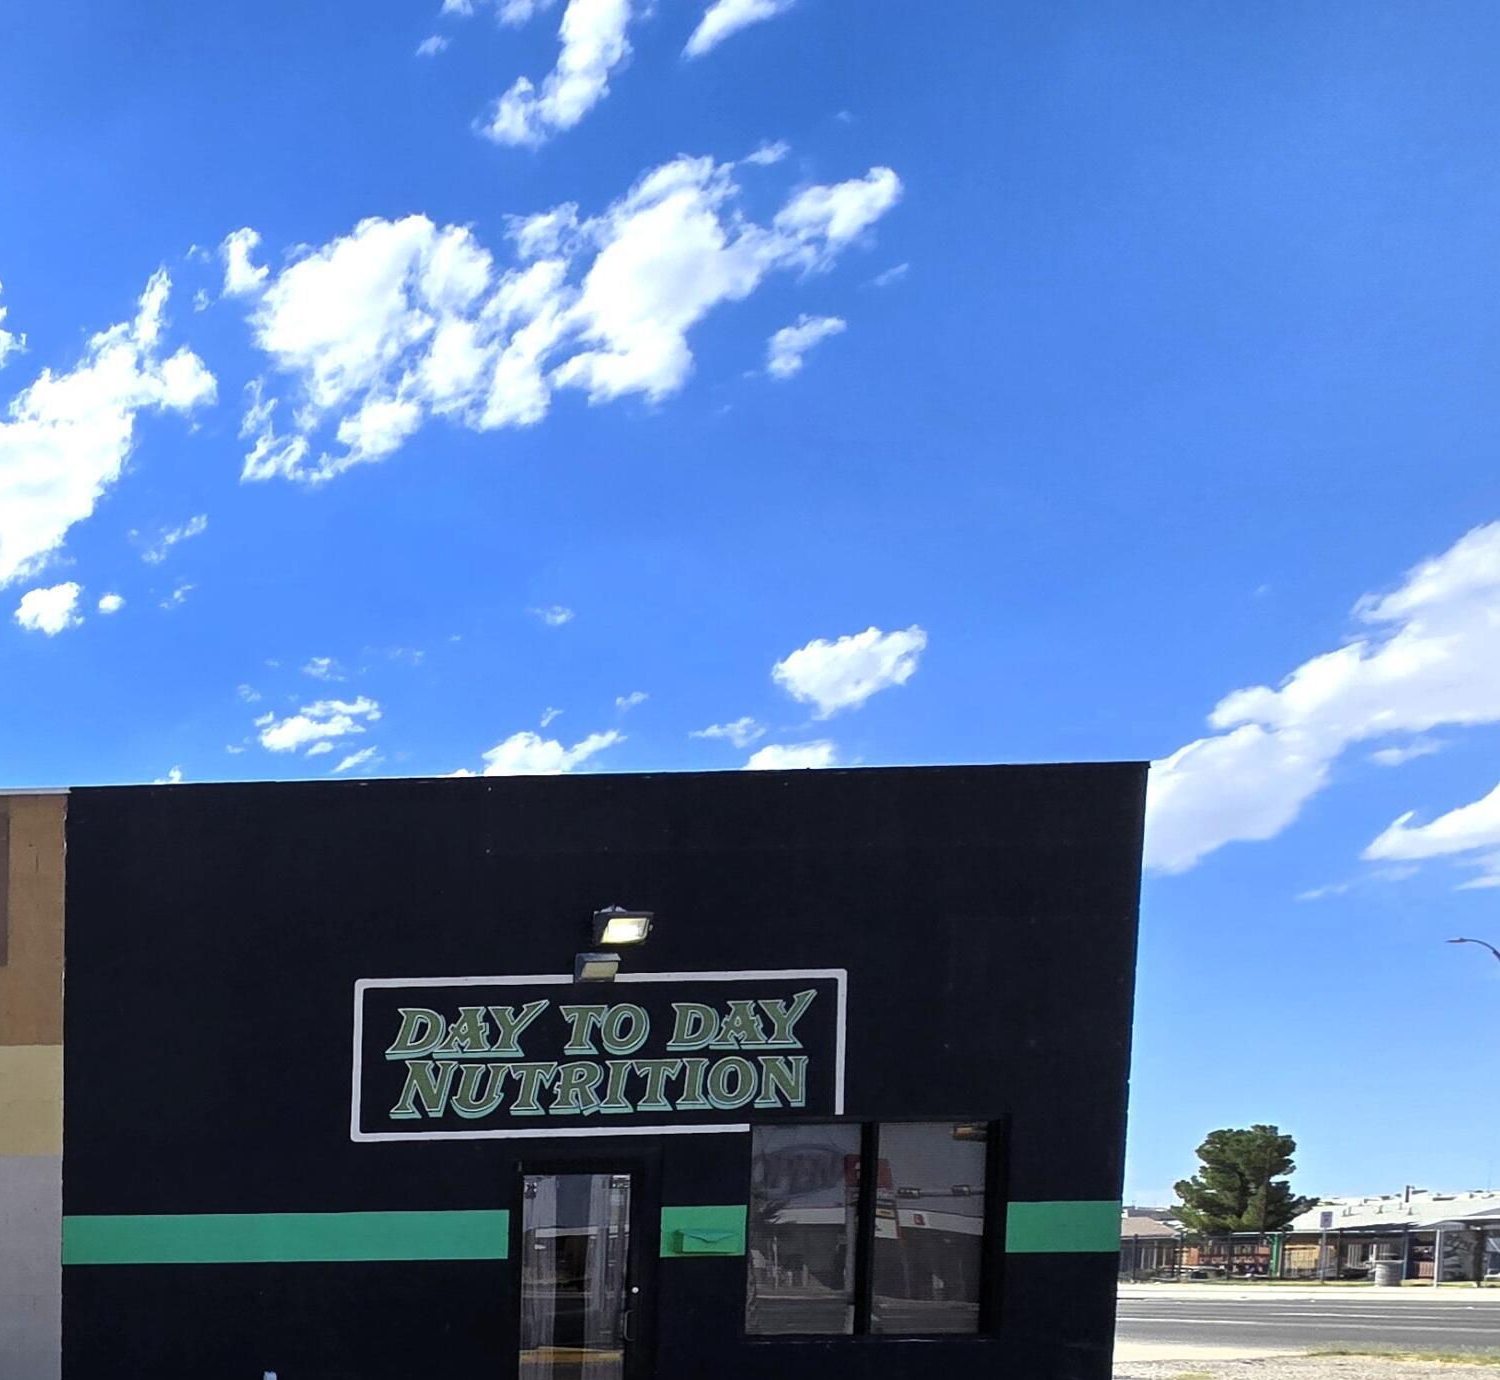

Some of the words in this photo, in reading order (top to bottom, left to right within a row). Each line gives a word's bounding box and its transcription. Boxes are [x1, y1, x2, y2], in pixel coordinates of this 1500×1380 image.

[384, 999, 550, 1060] DAY
[559, 1003, 650, 1055] TO
[666, 989, 818, 1052] DAY
[389, 1056, 809, 1119] NUTRITION
